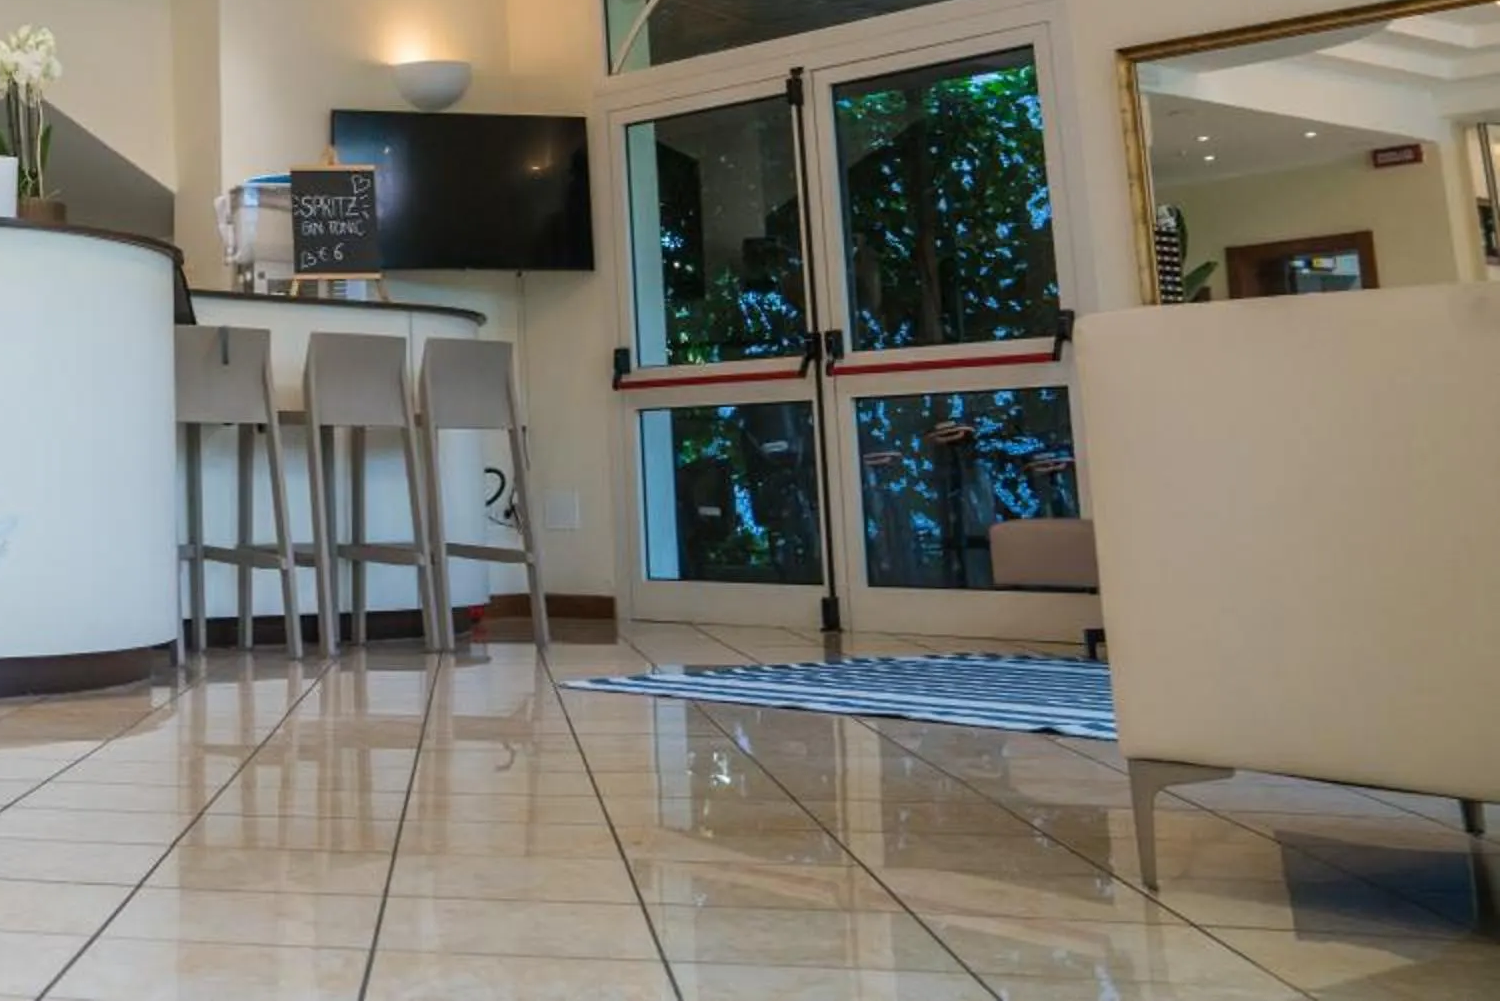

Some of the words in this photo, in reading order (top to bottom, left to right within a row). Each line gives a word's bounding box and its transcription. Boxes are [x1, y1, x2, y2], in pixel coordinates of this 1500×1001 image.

[300, 195, 359, 218] SPRITZ
[301, 220, 325, 236] GIN
[327, 219, 367, 237] TONIC
